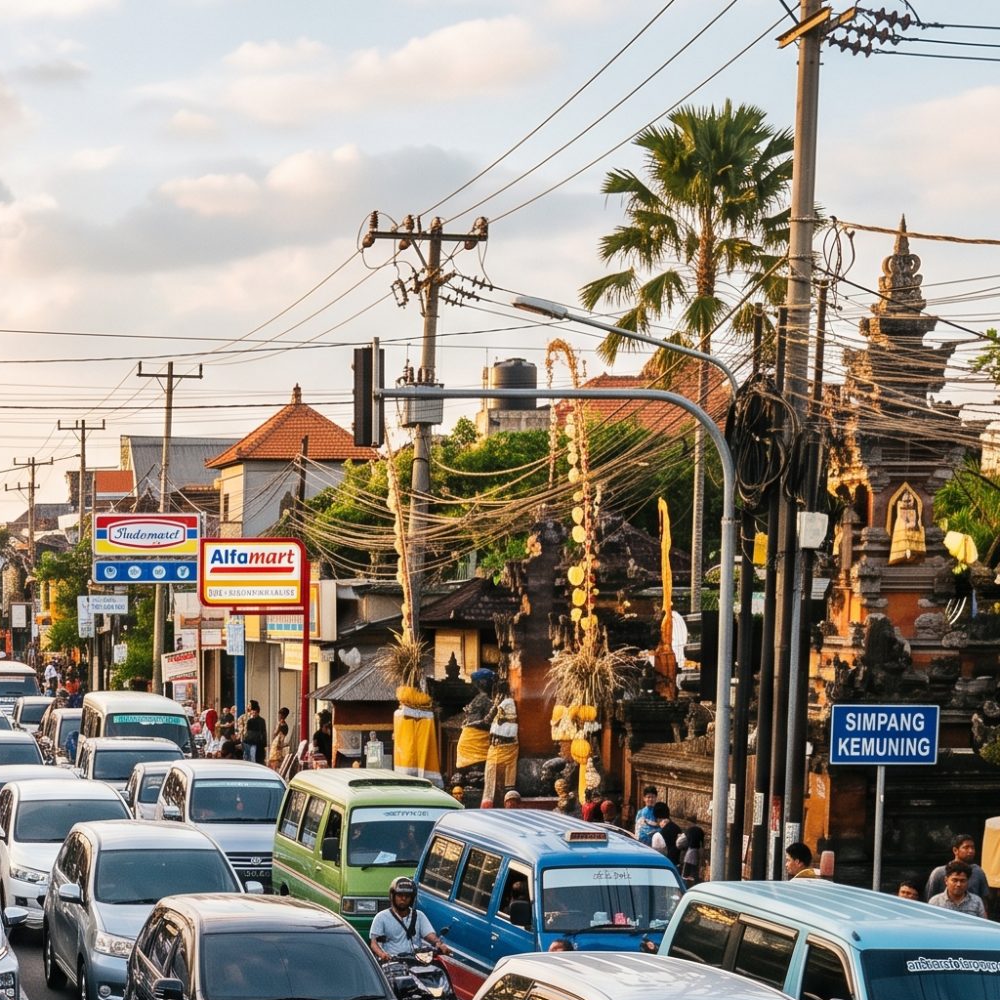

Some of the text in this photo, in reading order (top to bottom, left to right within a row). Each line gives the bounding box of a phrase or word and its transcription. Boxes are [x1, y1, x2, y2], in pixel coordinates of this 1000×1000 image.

[210, 548, 295, 565] Alfamart
[845, 712, 925, 732] SIMPANG
[838, 737, 930, 757] KEMUNING
